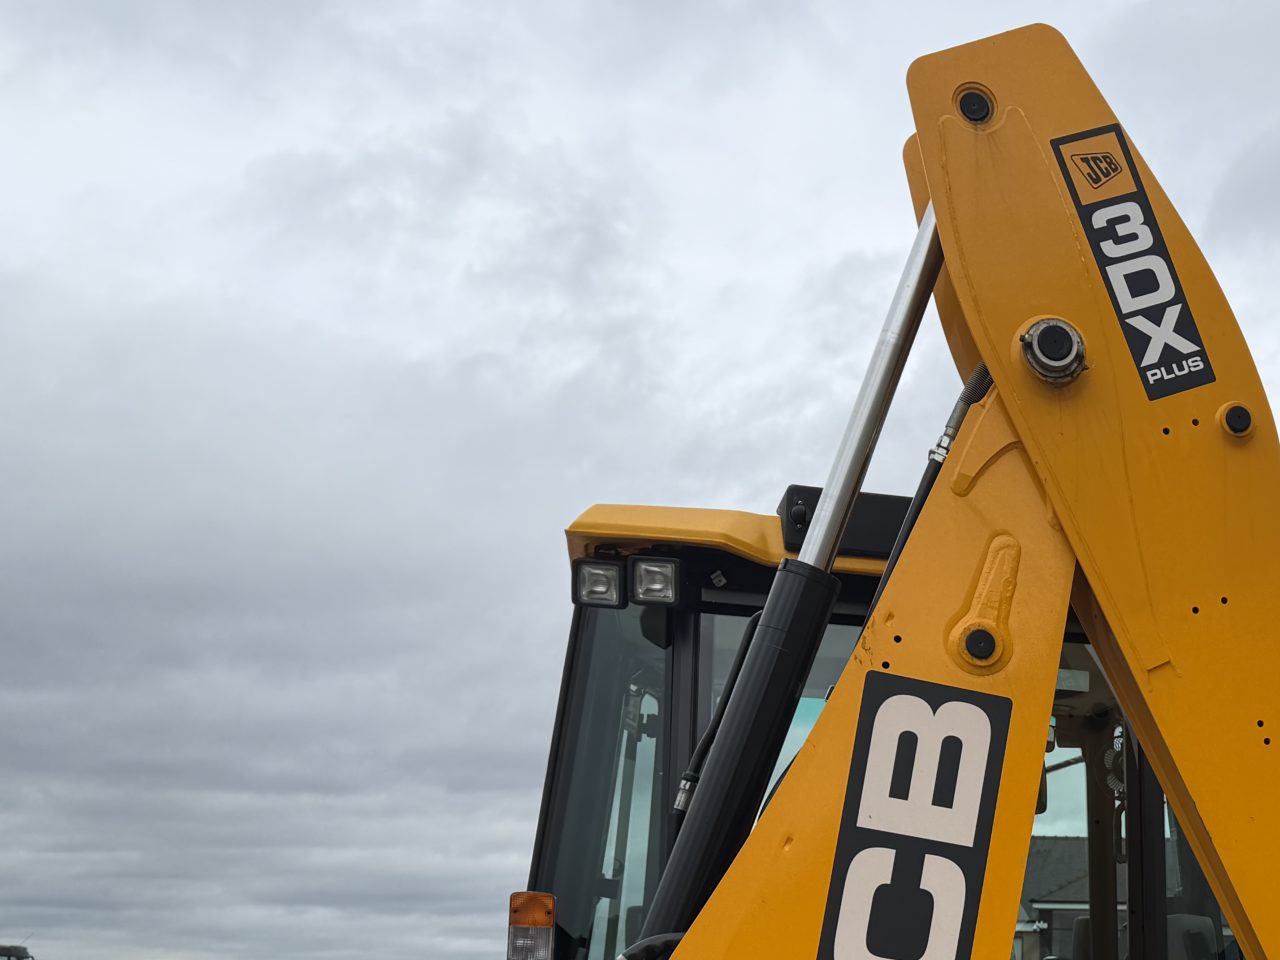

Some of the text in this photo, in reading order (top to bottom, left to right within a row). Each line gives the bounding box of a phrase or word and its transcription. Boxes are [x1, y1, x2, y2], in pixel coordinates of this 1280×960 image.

[1078, 153, 1119, 186] JCB
[1091, 201, 1201, 368] 3DX
[1146, 356, 1205, 385] PLUS
